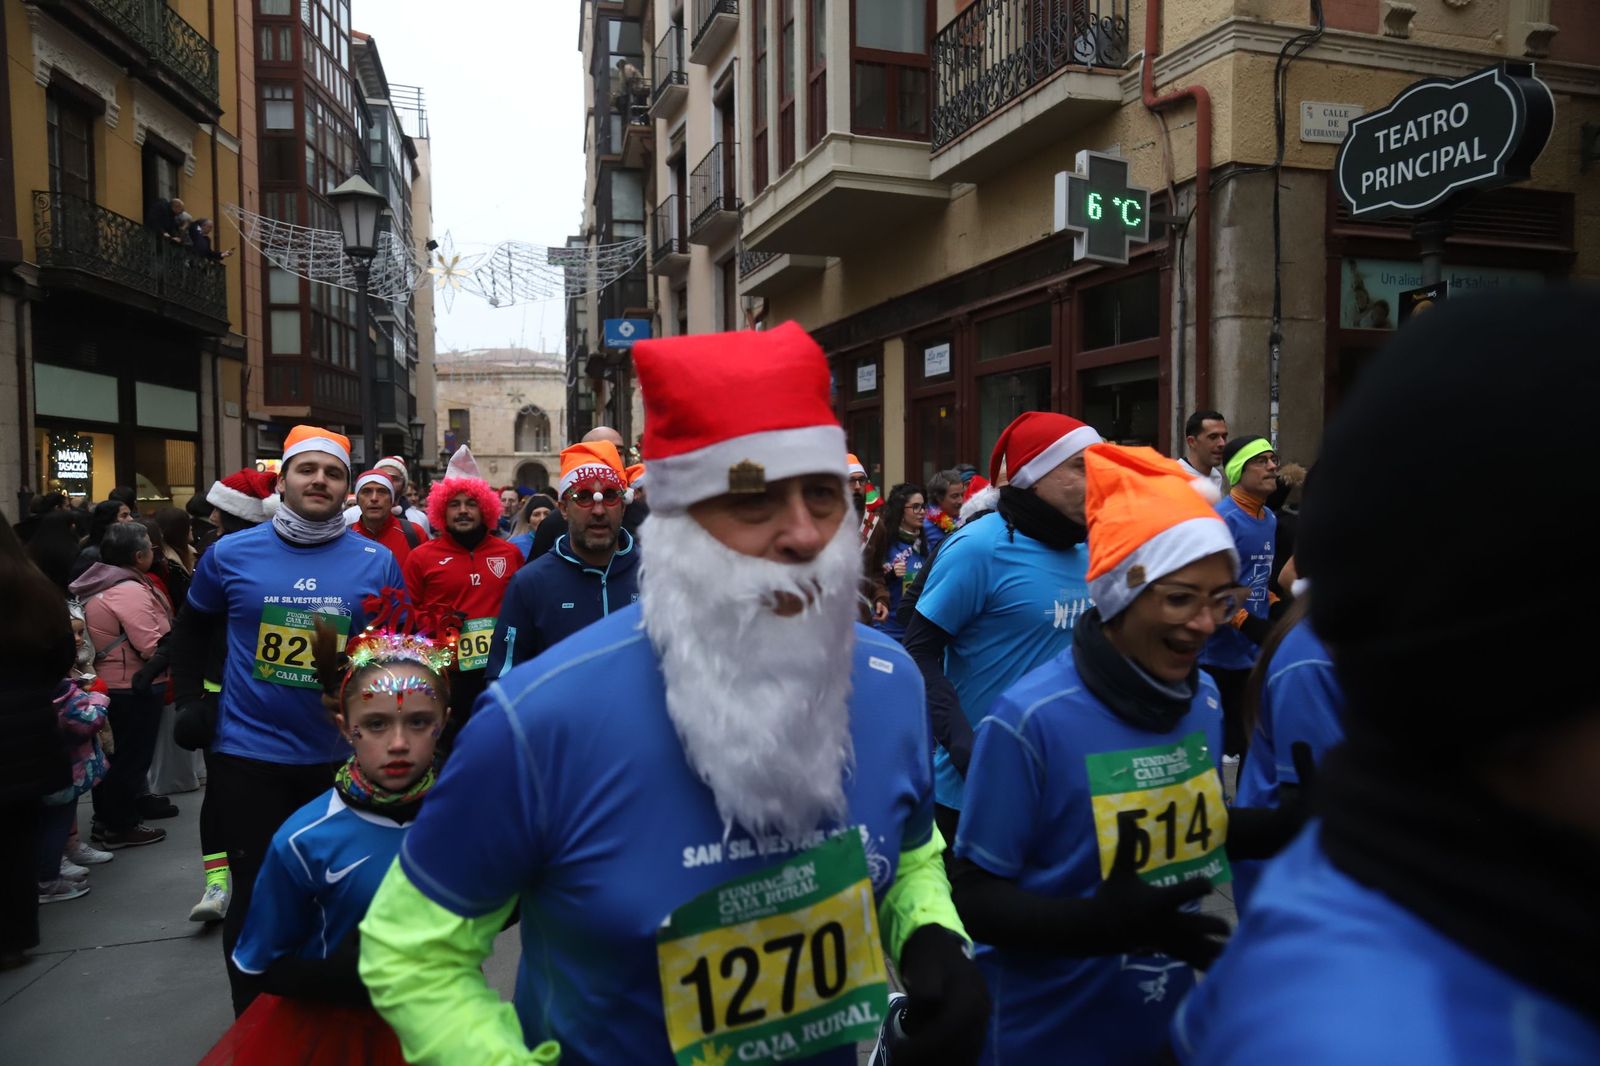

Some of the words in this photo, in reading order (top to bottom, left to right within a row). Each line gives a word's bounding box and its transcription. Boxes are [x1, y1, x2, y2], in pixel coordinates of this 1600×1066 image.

[1323, 108, 1349, 118] CALLE
[1327, 119, 1339, 127] DE
[1374, 102, 1469, 153] TEATRO
[1361, 136, 1487, 195] PRINCIPAL
[1088, 193, 1102, 219] 6
[1381, 272, 1397, 285] Un
[58, 449, 88, 462] MÁXIMA
[58, 461, 88, 471] TASACIÓN
[293, 578, 317, 591] 46
[469, 573, 481, 586] 12
[281, 596, 322, 604] SILVESTRE
[261, 632, 318, 668] 82
[460, 634, 492, 657] 96
[275, 670, 299, 682] CAJA
[683, 844, 722, 868] SAN
[764, 878, 820, 905] RURAL
[680, 921, 848, 1035] 1270
[738, 1031, 798, 1062] CAJA
[803, 1001, 881, 1043] RURAL
